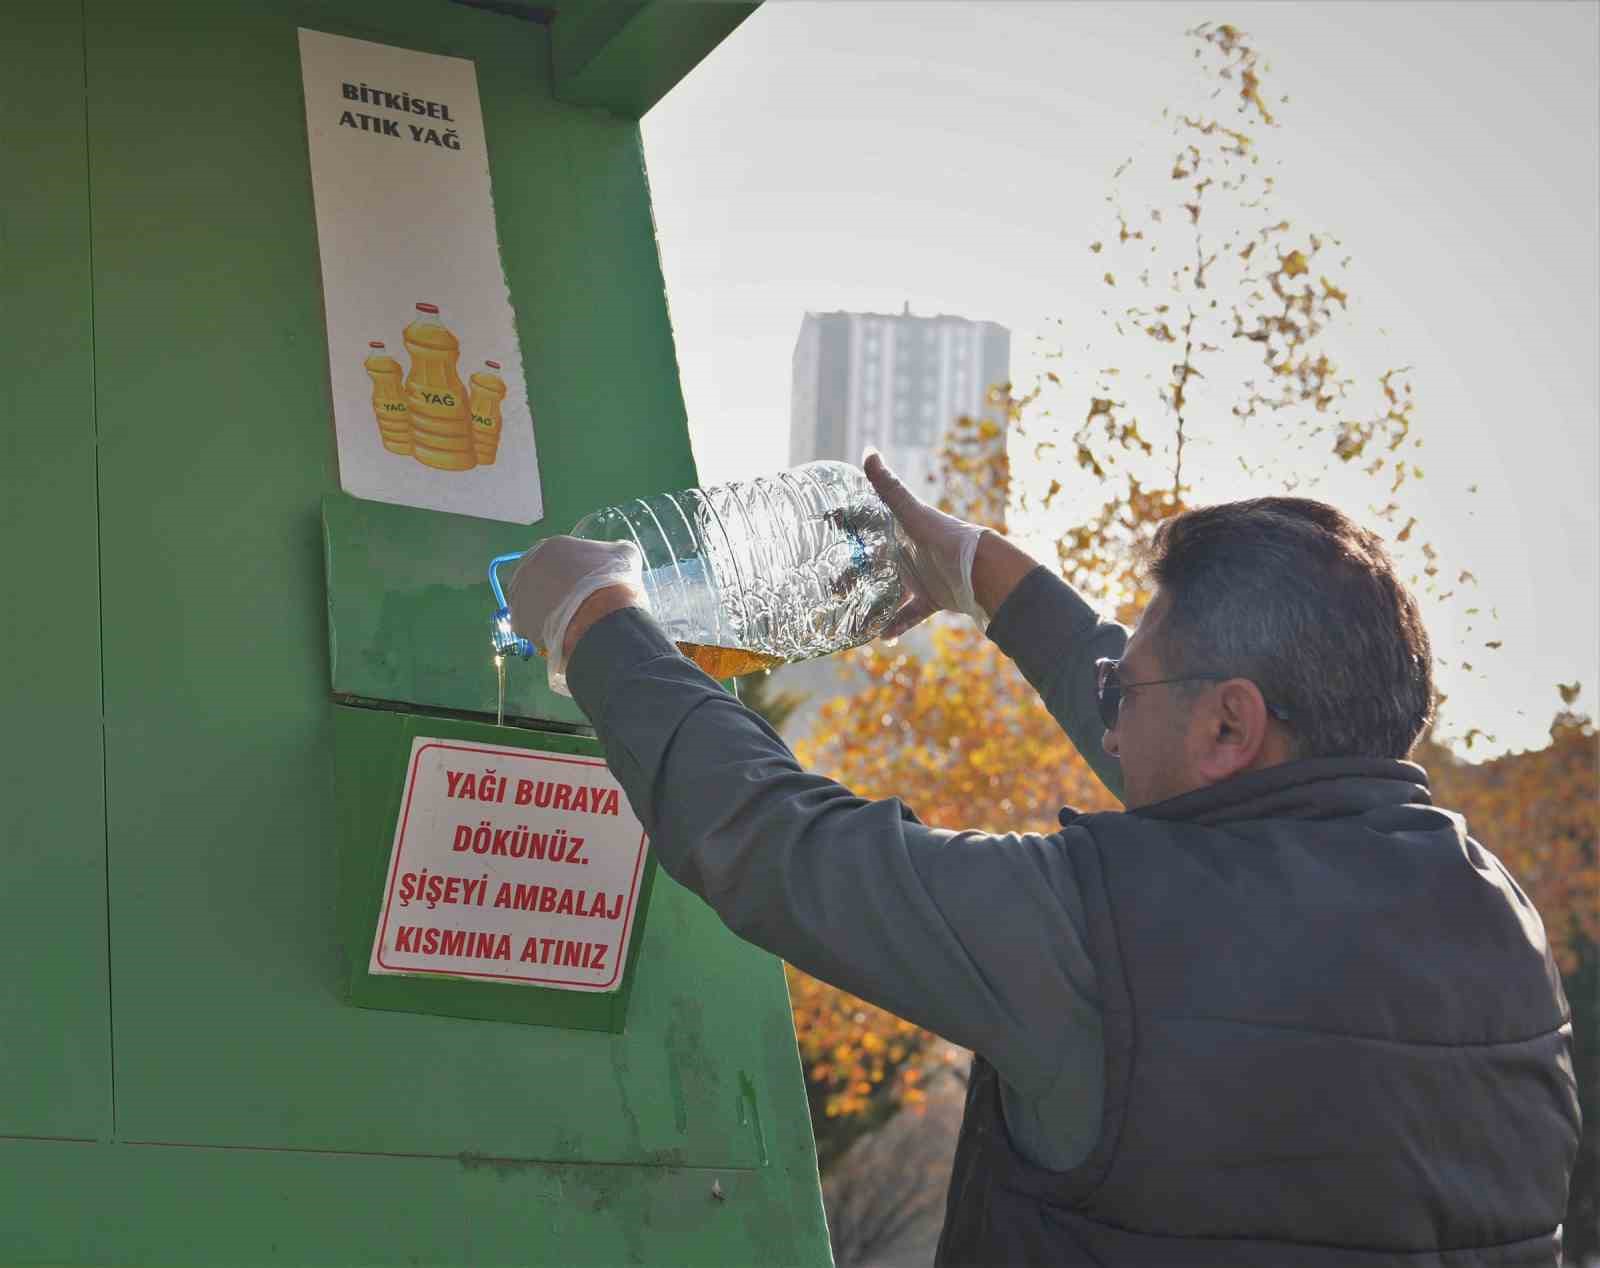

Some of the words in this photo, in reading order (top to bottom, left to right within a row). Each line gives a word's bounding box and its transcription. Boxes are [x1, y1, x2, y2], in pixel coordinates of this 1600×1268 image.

[342, 82, 455, 122] BİTKİSEL
[339, 111, 401, 138] ATIK
[408, 124, 460, 150] YAĞ
[447, 768, 508, 803] YAĞI
[515, 779, 619, 816] BURAYA
[453, 820, 590, 865] DÖKÜNÜZ.
[399, 868, 489, 910] ŞİŞEYİ
[494, 882, 624, 920] AMBALAJ
[395, 925, 512, 961] KISMINA
[520, 937, 609, 970] ATINIZ
